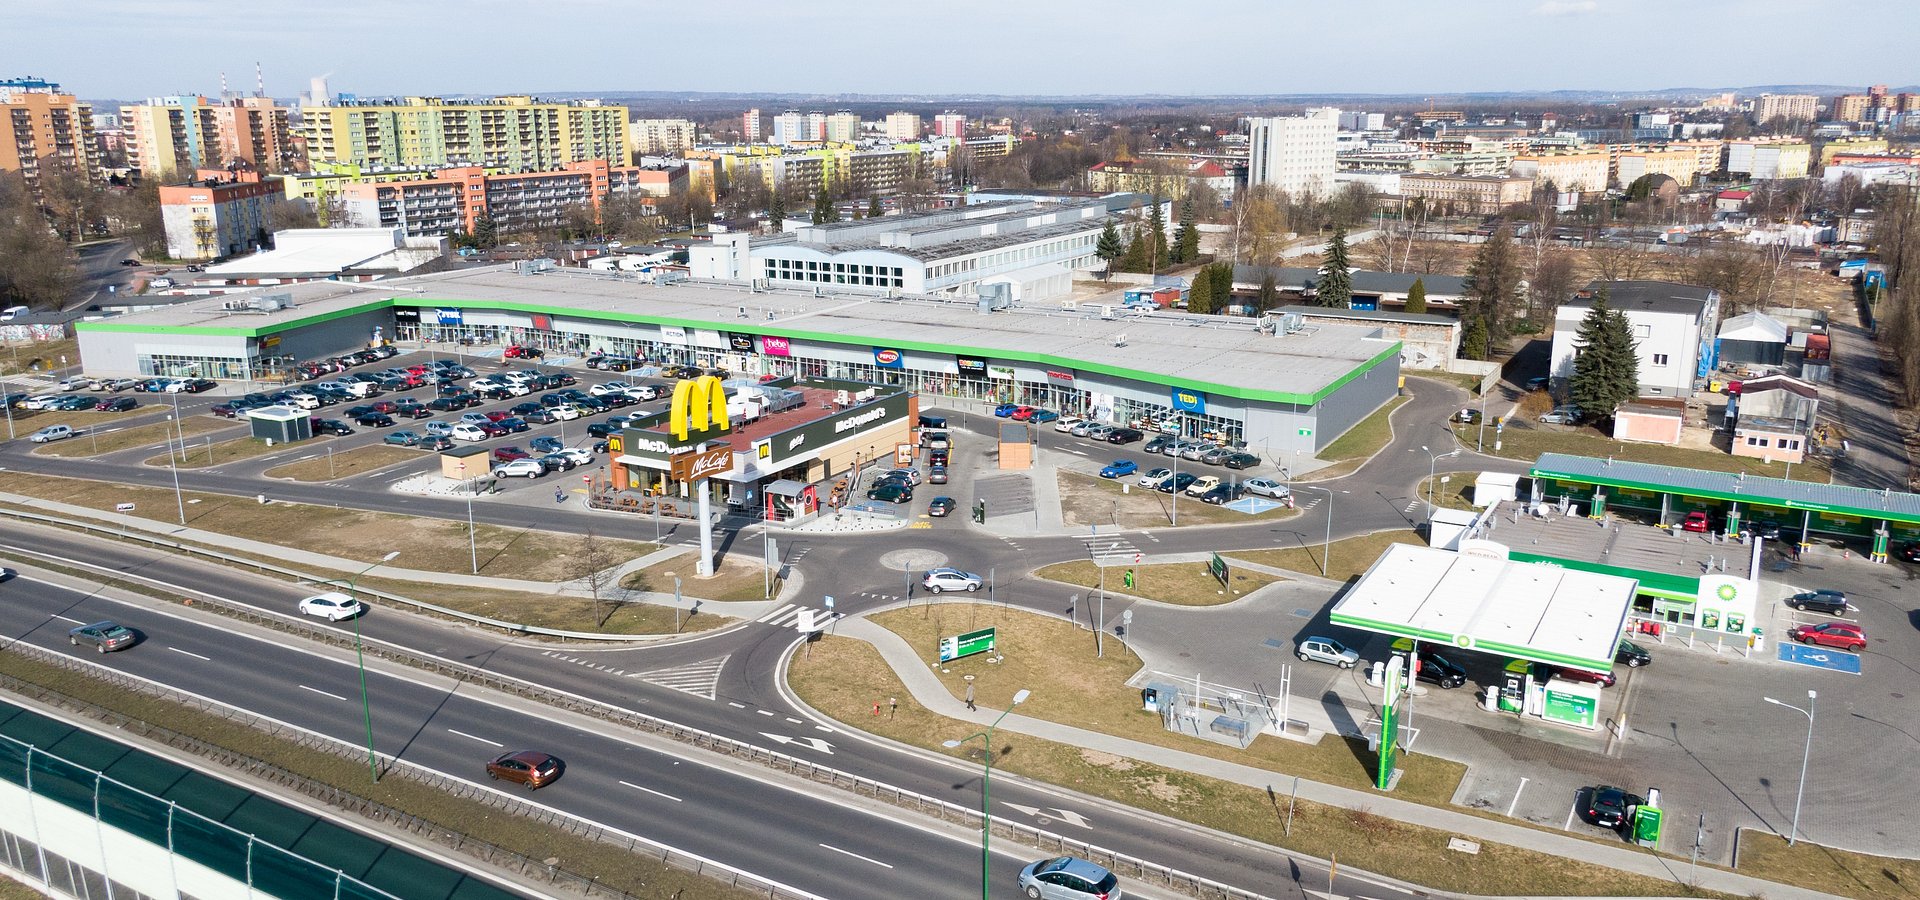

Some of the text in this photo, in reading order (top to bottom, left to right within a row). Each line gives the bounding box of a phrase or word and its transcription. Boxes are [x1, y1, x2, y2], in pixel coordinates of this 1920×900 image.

[442, 311, 460, 319] JYSK
[665, 330, 683, 338] ACTION
[767, 338, 786, 348] hebe
[1047, 371, 1073, 381] martes
[835, 407, 886, 433] McDonald's
